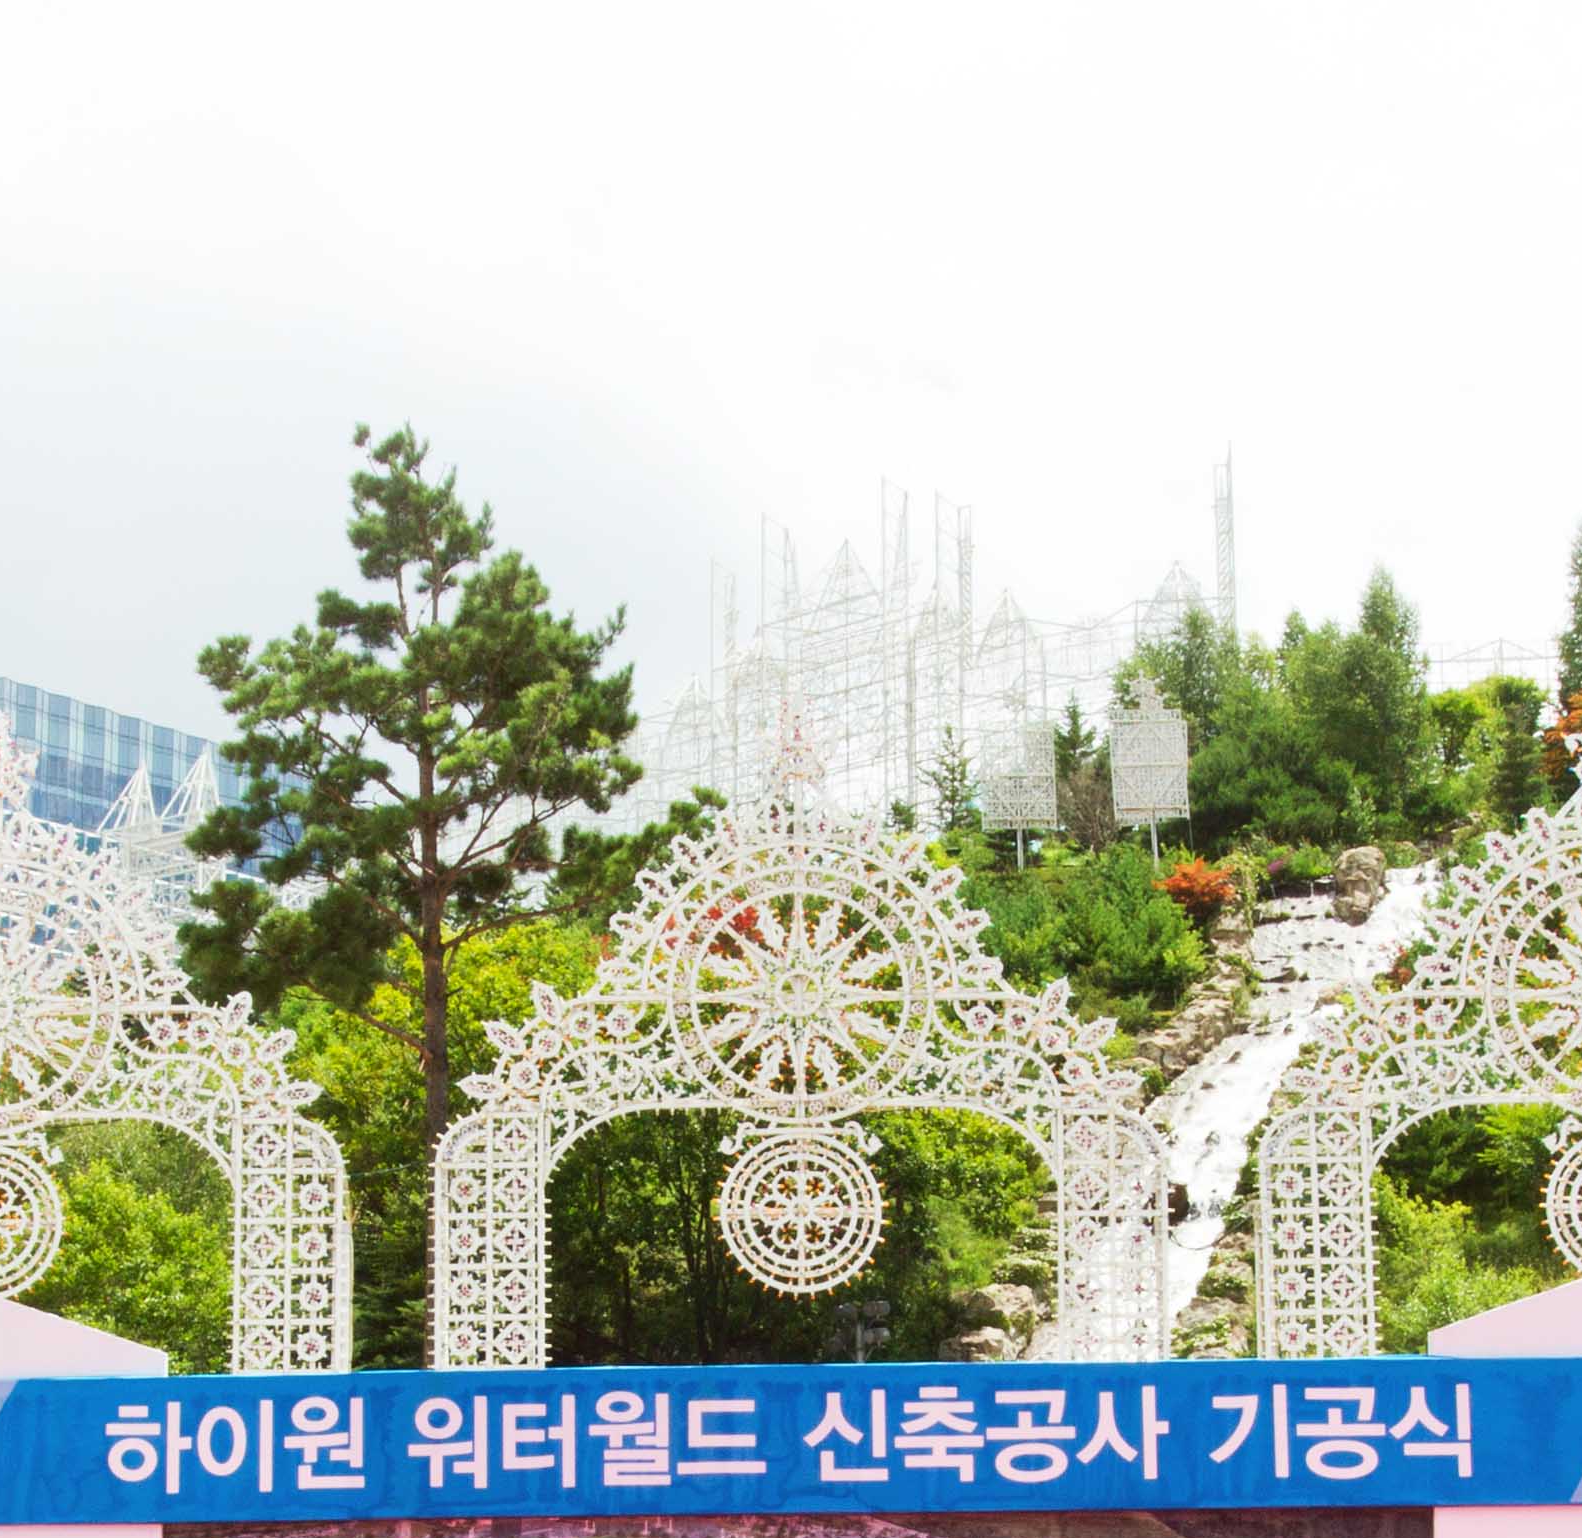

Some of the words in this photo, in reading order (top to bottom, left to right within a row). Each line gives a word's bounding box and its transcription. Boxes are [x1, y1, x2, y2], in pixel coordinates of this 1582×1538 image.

[106, 1397, 364, 1493] 하이원
[408, 1391, 766, 1488] 워터월드
[804, 1386, 1169, 1482] 신축공사
[1211, 1384, 1472, 1479] 기공식
